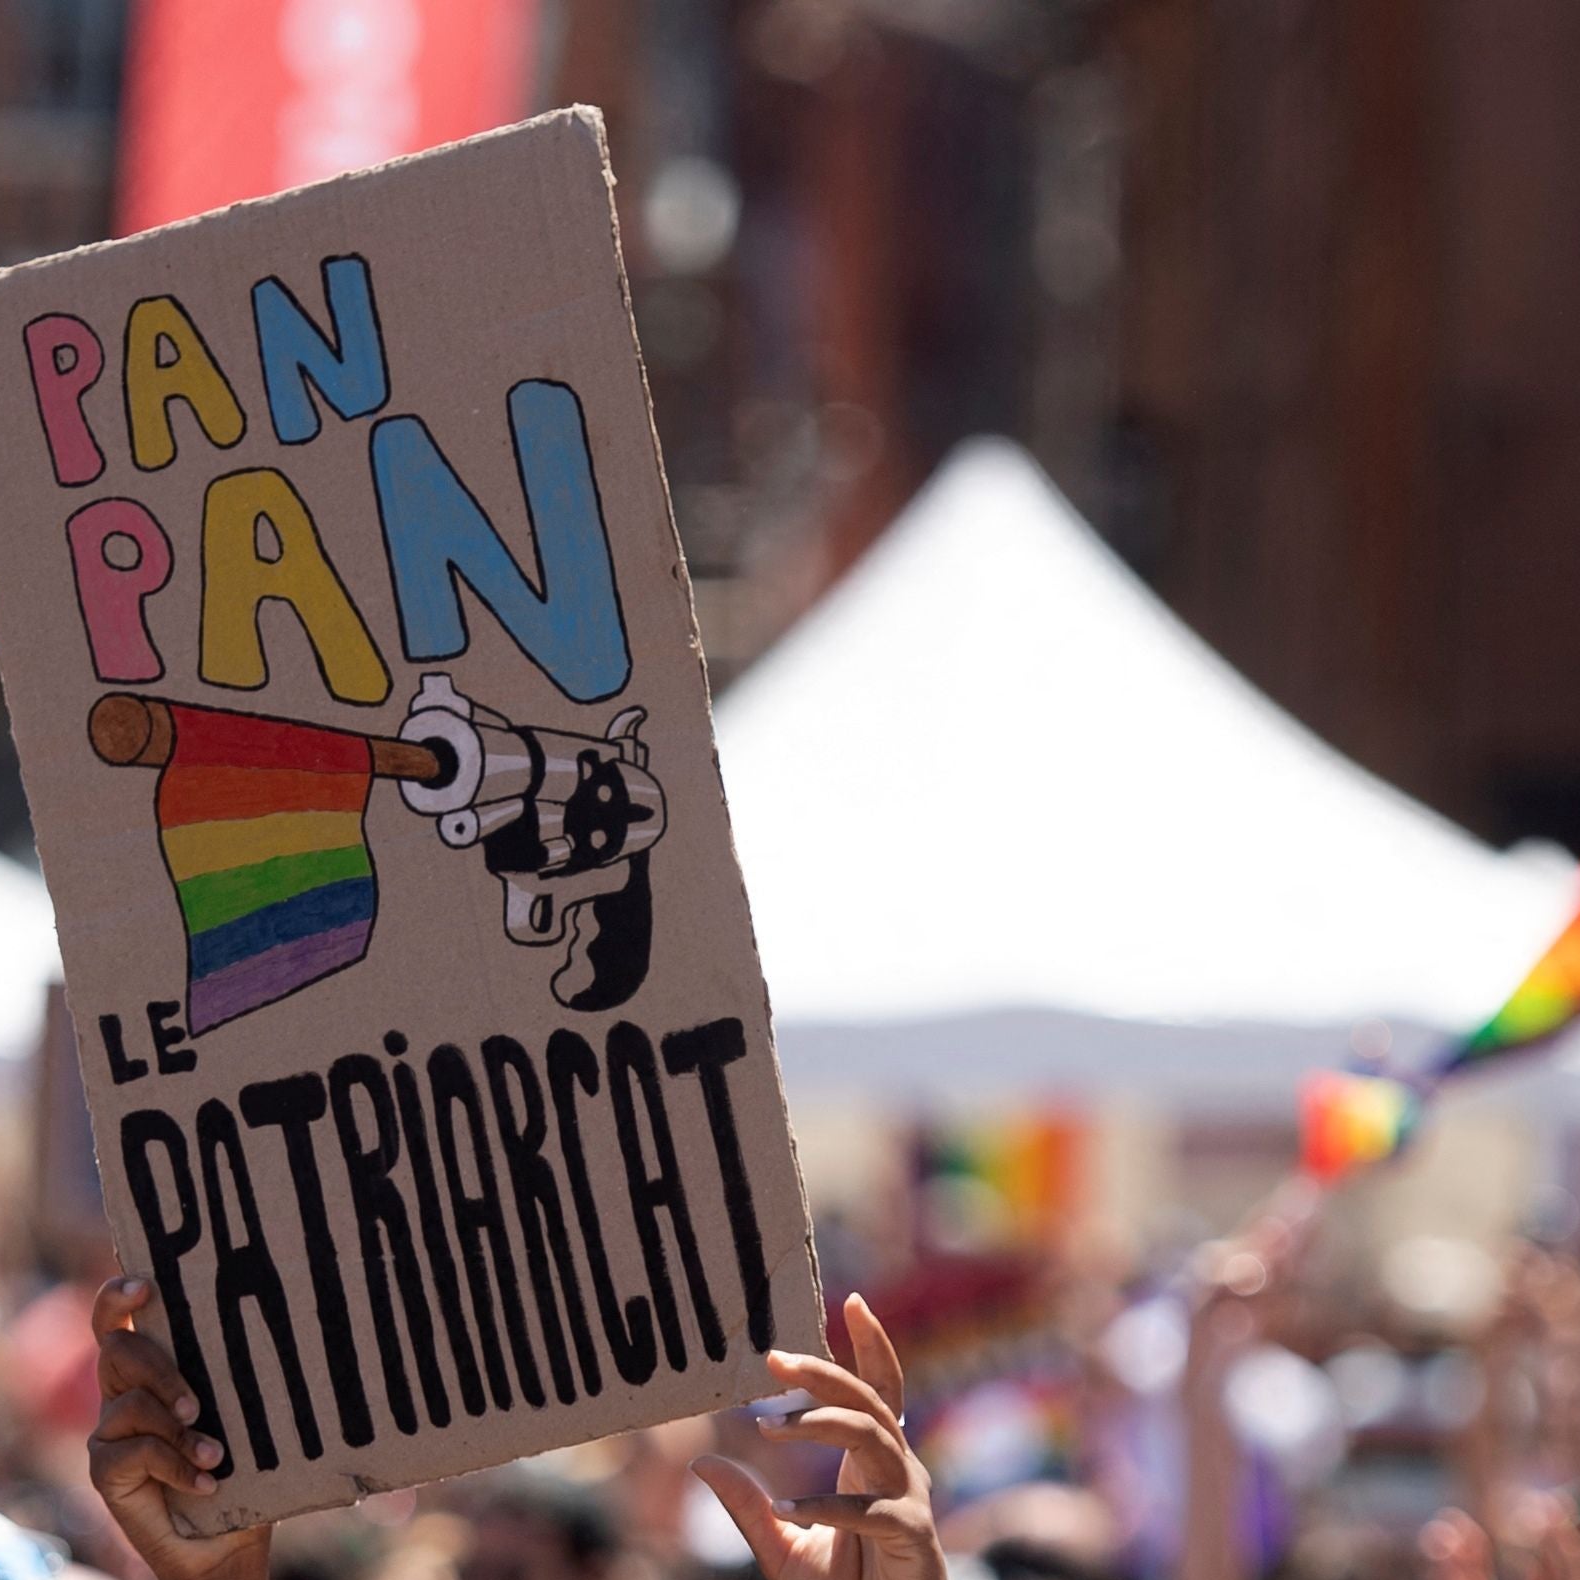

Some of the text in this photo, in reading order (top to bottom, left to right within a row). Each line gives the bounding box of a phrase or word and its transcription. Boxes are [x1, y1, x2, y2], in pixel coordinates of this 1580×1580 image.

[23, 253, 391, 488] PAN
[65, 378, 633, 705] PAN
[99, 1000, 197, 1084] LE
